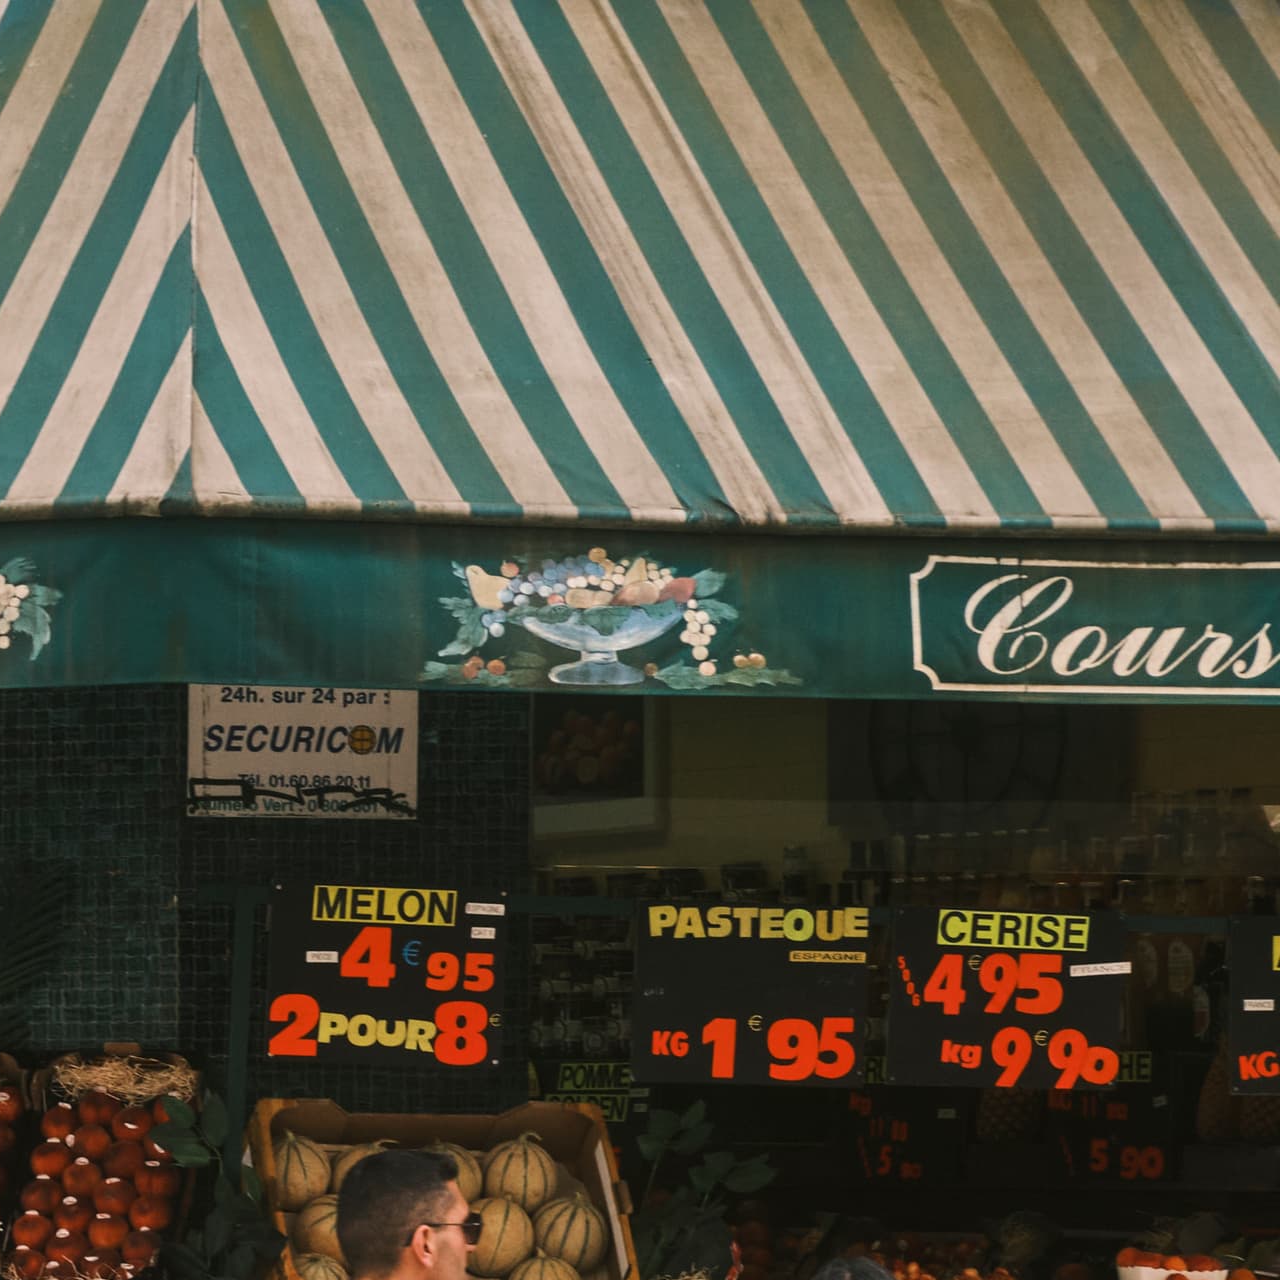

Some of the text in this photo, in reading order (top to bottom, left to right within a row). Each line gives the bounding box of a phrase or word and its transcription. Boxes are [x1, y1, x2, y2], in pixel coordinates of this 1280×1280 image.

[963, 573, 1280, 680] Cours
[220, 686, 263, 704] 24h.
[272, 689, 306, 704] sur
[311, 688, 336, 704] 24
[342, 690, 376, 708] par
[203, 724, 405, 755] SECURICOM
[315, 887, 455, 924] MELON
[940, 910, 1088, 950] CERISE
[792, 952, 863, 962] ESPAGNE
[268, 993, 321, 1057] 2
[317, 1011, 438, 1053] POUR
[651, 1030, 690, 1058] KG
[940, 1039, 984, 1070] kg
[1238, 1051, 1280, 1081] KG
